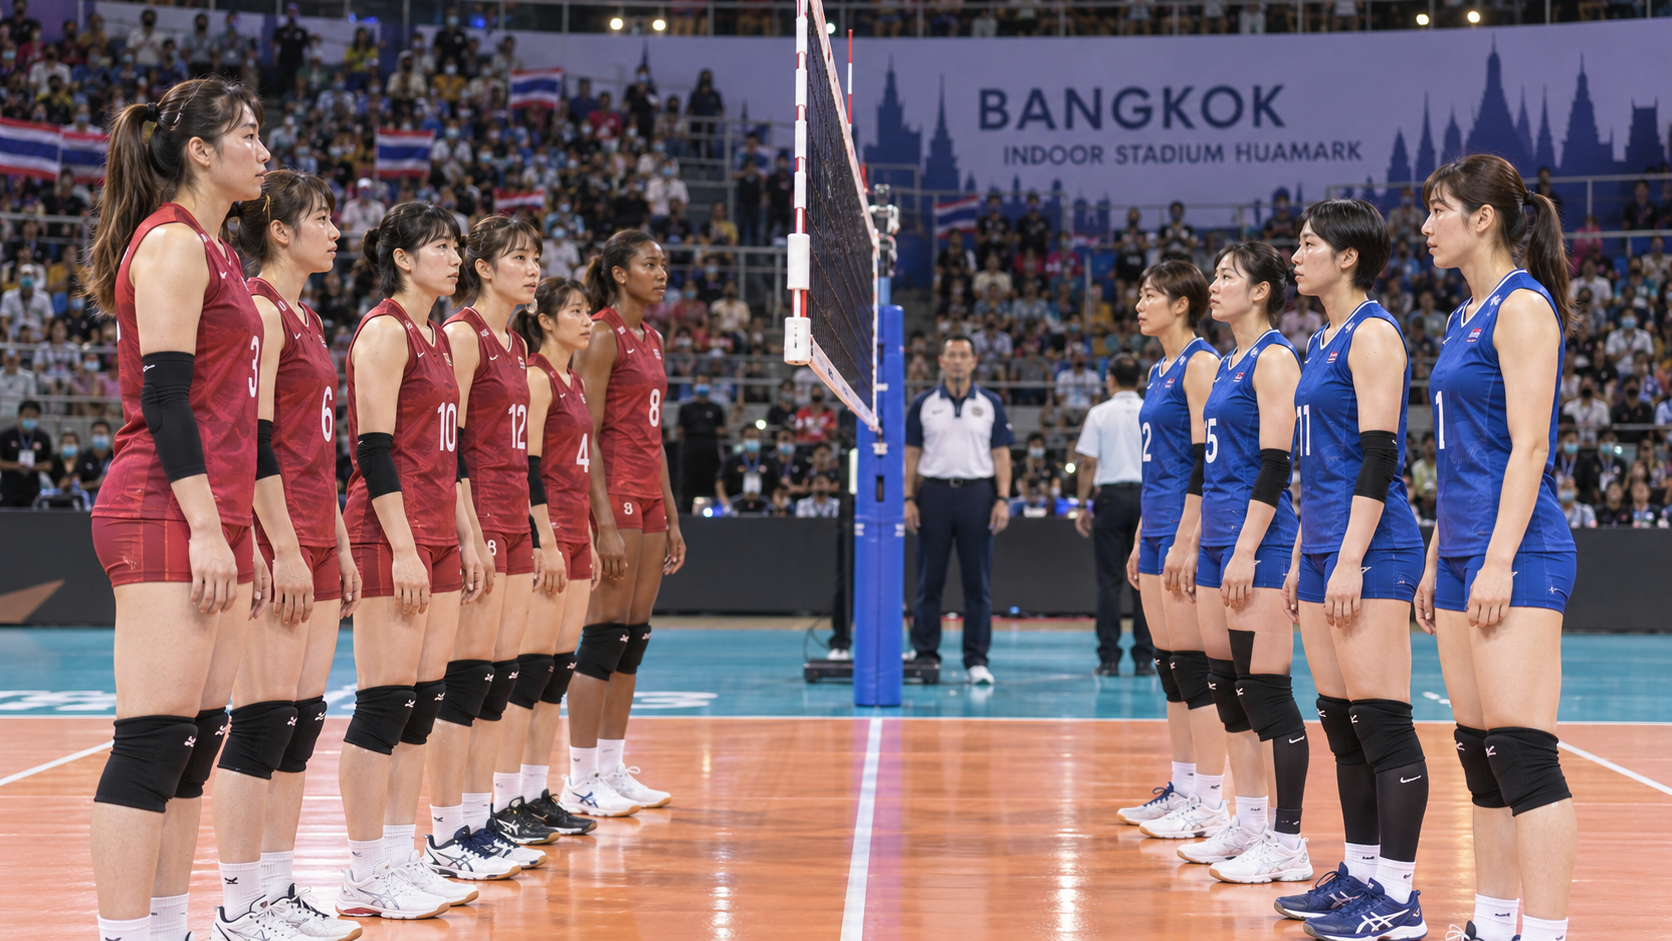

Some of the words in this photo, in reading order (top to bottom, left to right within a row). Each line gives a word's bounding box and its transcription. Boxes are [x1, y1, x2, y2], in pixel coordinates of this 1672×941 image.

[979, 84, 1286, 131] BANGKOK
[1003, 144, 1104, 166] INDOOR
[1115, 143, 1225, 165] STADIUM
[1235, 140, 1363, 163] HUAMARK
[248, 335, 260, 398] 3
[321, 385, 333, 442] 6
[437, 402, 457, 452] 10
[508, 403, 527, 450] 12
[649, 388, 661, 427] 8
[1435, 390, 1445, 450] 1
[576, 433, 590, 473] 4
[1205, 418, 1218, 464] 5
[623, 502, 633, 515] 8
